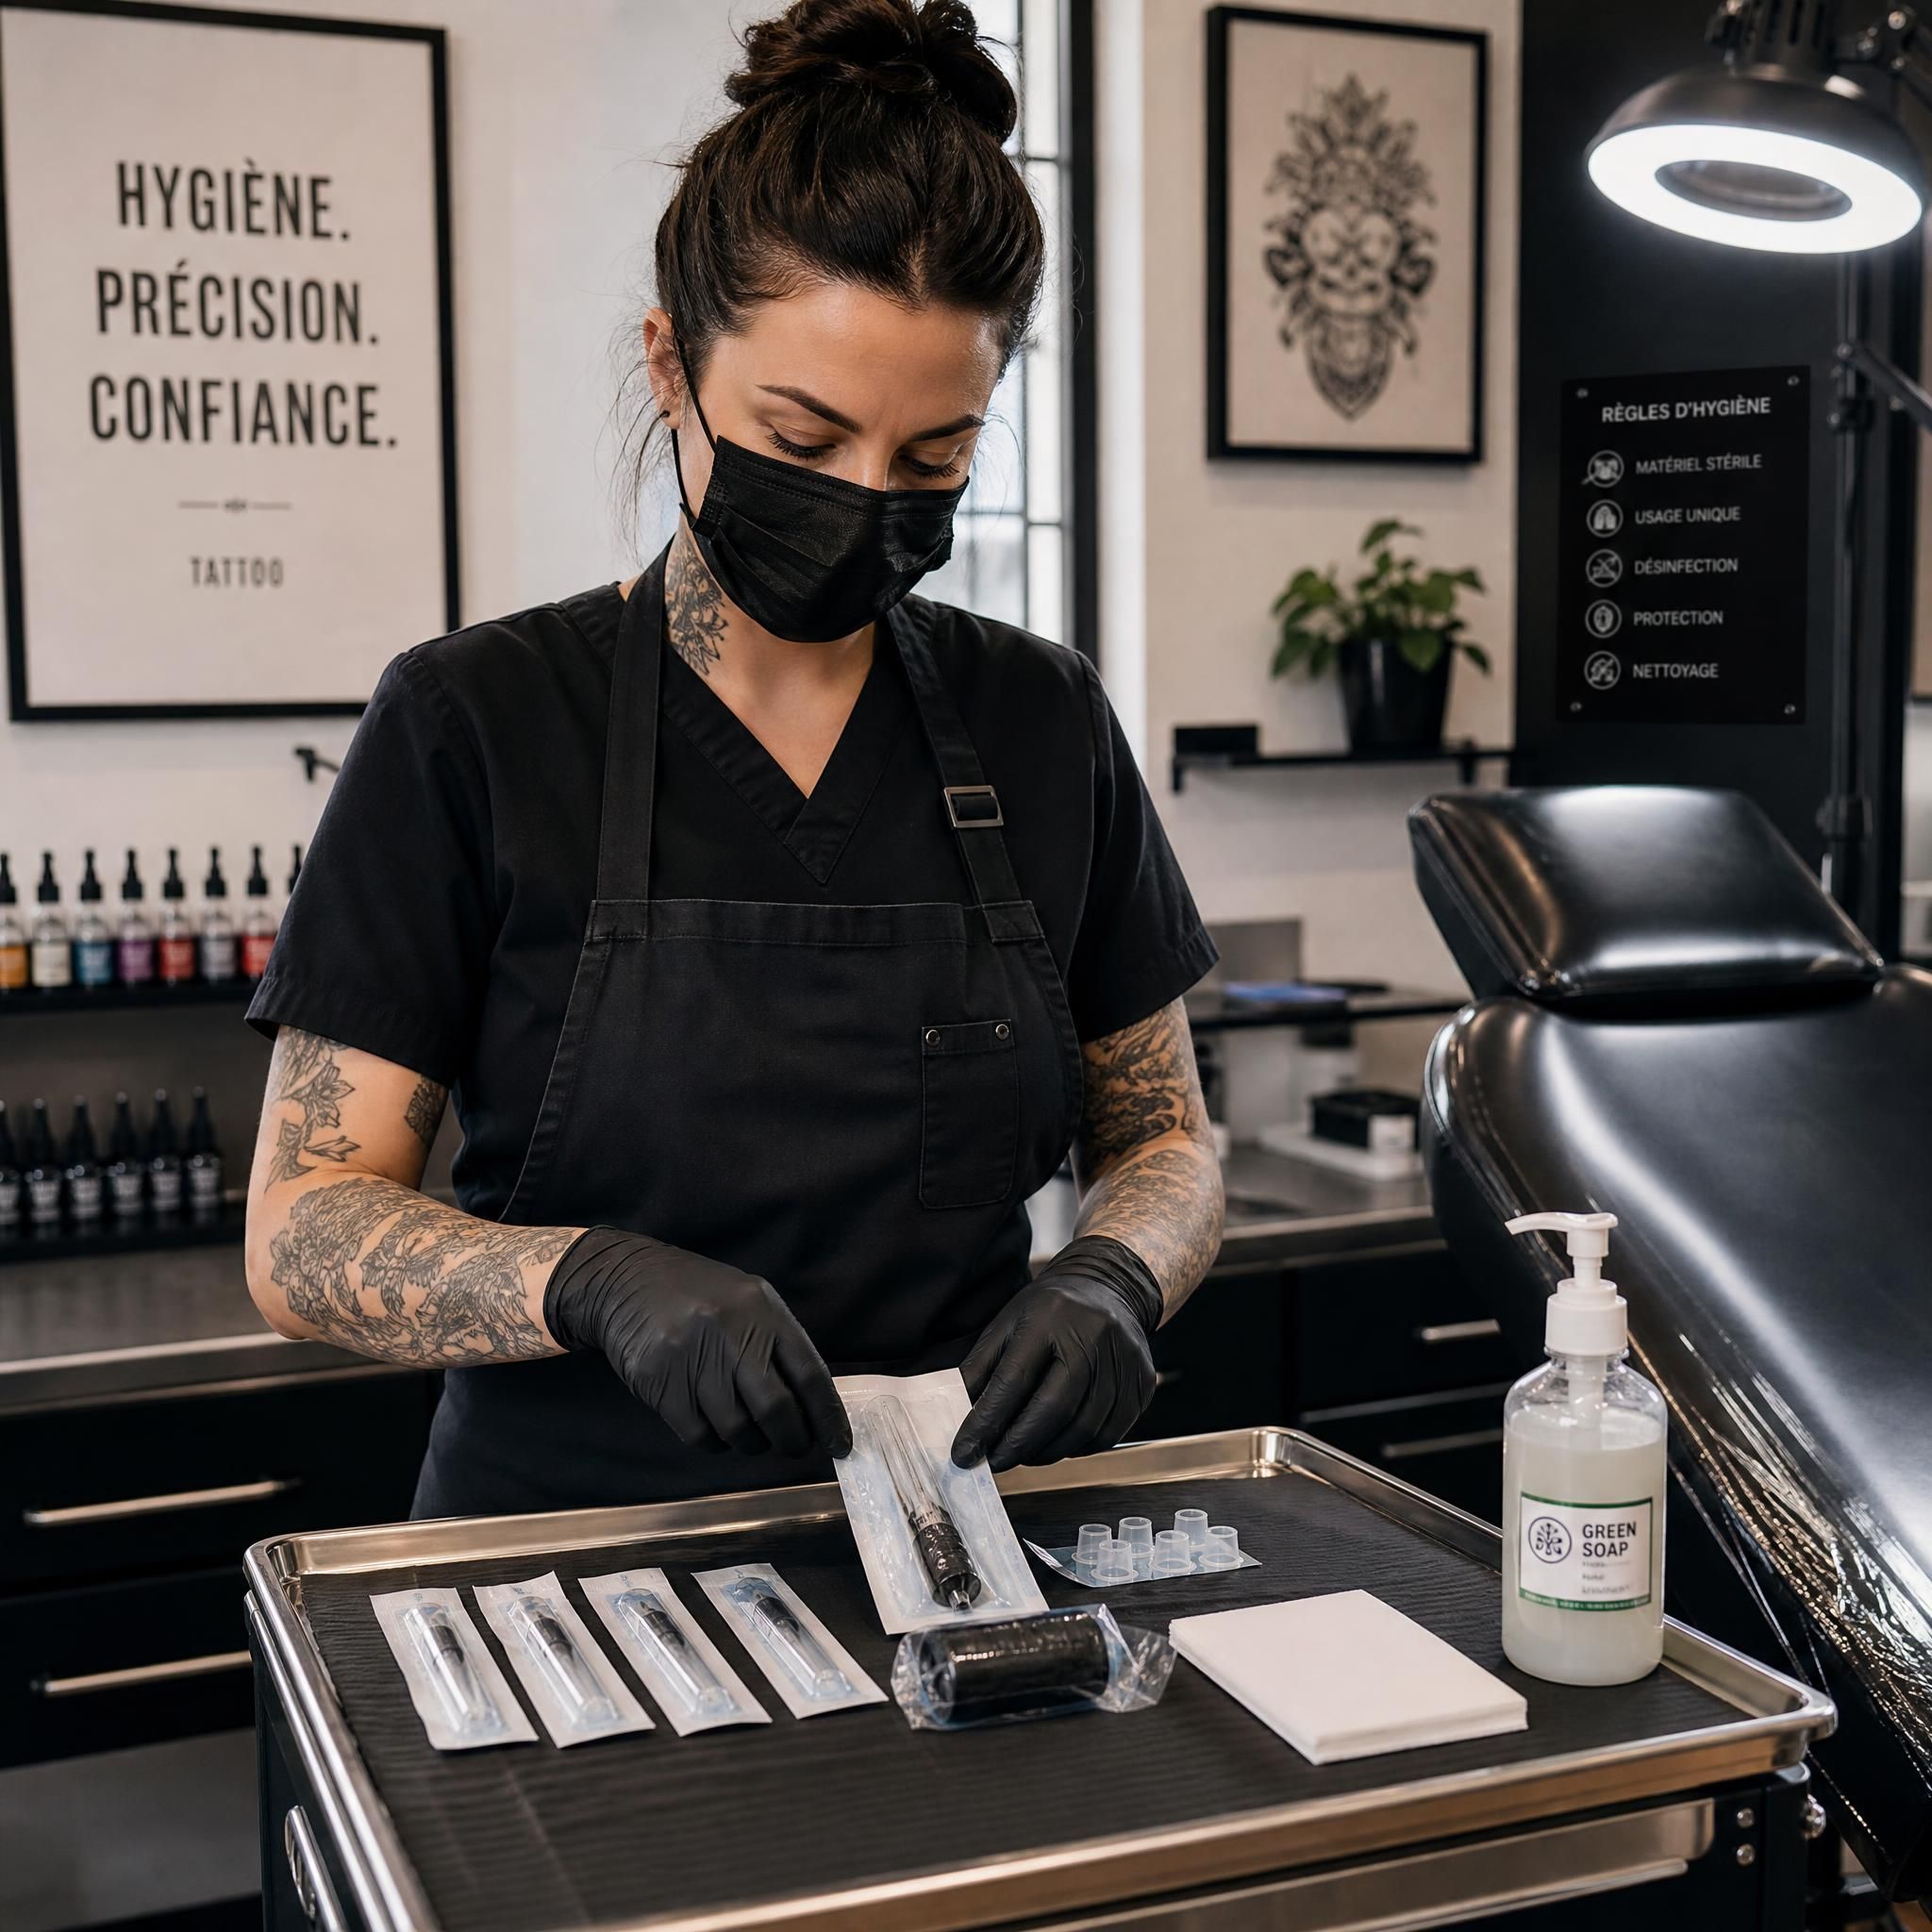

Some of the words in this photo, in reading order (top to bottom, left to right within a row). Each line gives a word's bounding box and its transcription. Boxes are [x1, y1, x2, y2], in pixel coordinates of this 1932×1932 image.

[117, 158, 350, 241] HYGIÈNE.
[96, 259, 378, 344] PRÉCISION.
[90, 375, 397, 447] CONFIANCE.
[1602, 402, 1671, 423] RÈGLES
[1675, 395, 1771, 419] D'HYGIÈNE
[1636, 457, 1702, 475] MATÉRIEL
[1706, 453, 1762, 471] STÉRILE
[1635, 508, 1682, 525] USAGE
[1686, 507, 1740, 523] UNIQUE
[191, 558, 283, 587] TATTOO
[1634, 558, 1739, 575] DÉSINFECTION
[1633, 610, 1724, 626] PROTECTION
[1633, 663, 1719, 678] NETTOYAGE
[1582, 1521, 1637, 1539] GREEN
[1582, 1541, 1628, 1557] SOAP
